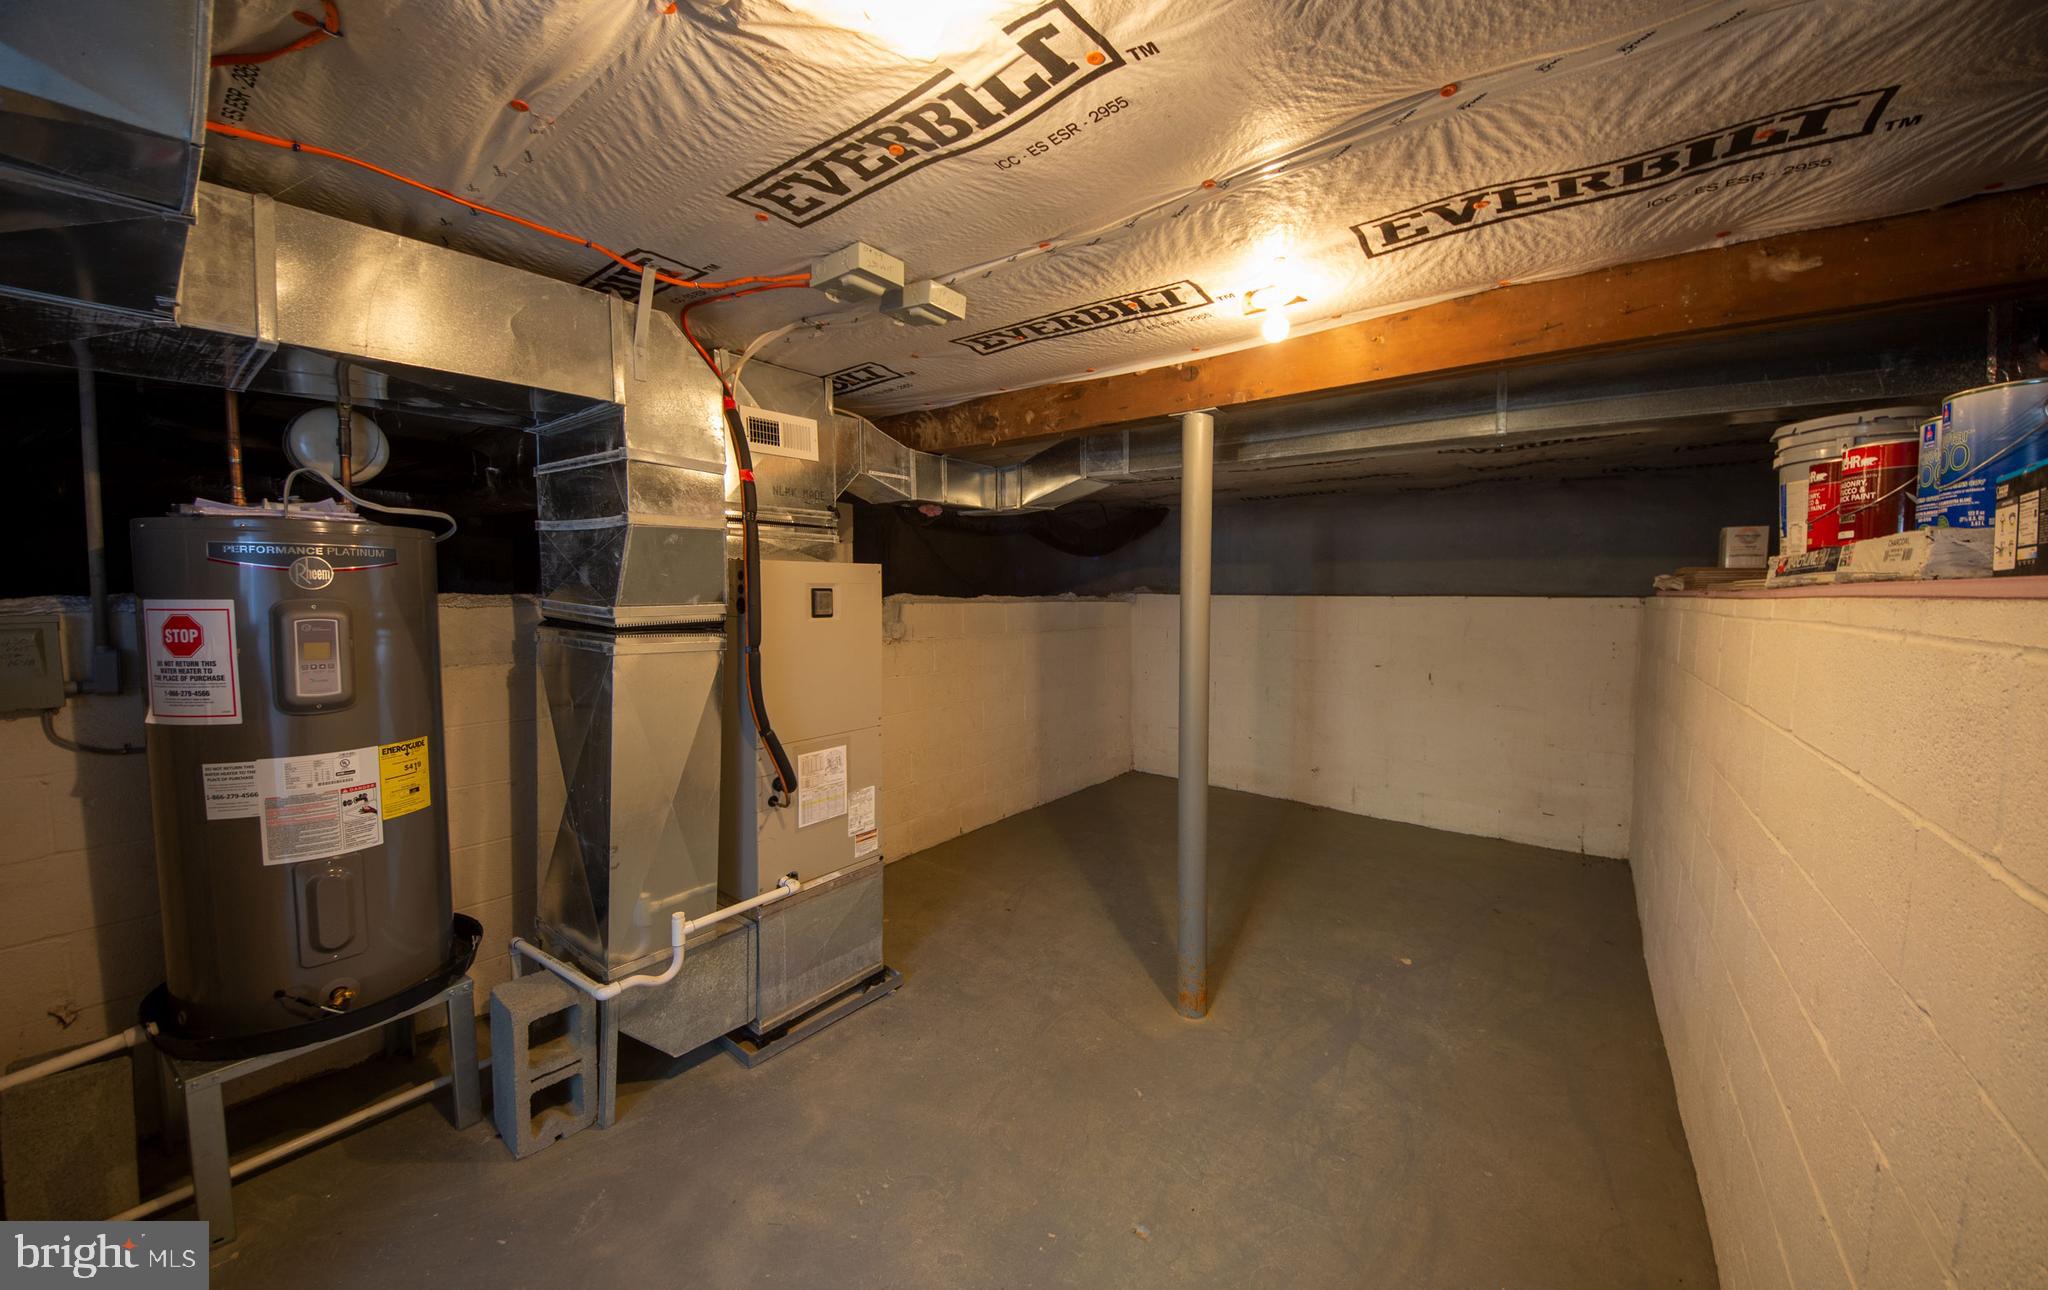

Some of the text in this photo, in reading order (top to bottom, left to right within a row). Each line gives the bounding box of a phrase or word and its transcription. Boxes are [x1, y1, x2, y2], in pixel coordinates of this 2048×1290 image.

[755, 22, 1080, 216] EVERBILT
[994, 155, 1022, 171] ICC
[1026, 141, 1050, 157] ES
[1047, 122, 1082, 146] ESR
[1088, 96, 1129, 123] 2955
[1372, 101, 1923, 247] EVERBILT TM
[1783, 157, 1832, 176] 2955
[968, 286, 1187, 352] EVERBILT
[1851, 491, 1876, 502] PAINT
[223, 544, 385, 558] PERFORMANCE PLATINUM
[295, 557, 331, 584] Rheem
[165, 628, 199, 643] STOP
[189, 674, 225, 682] PURCHASE
